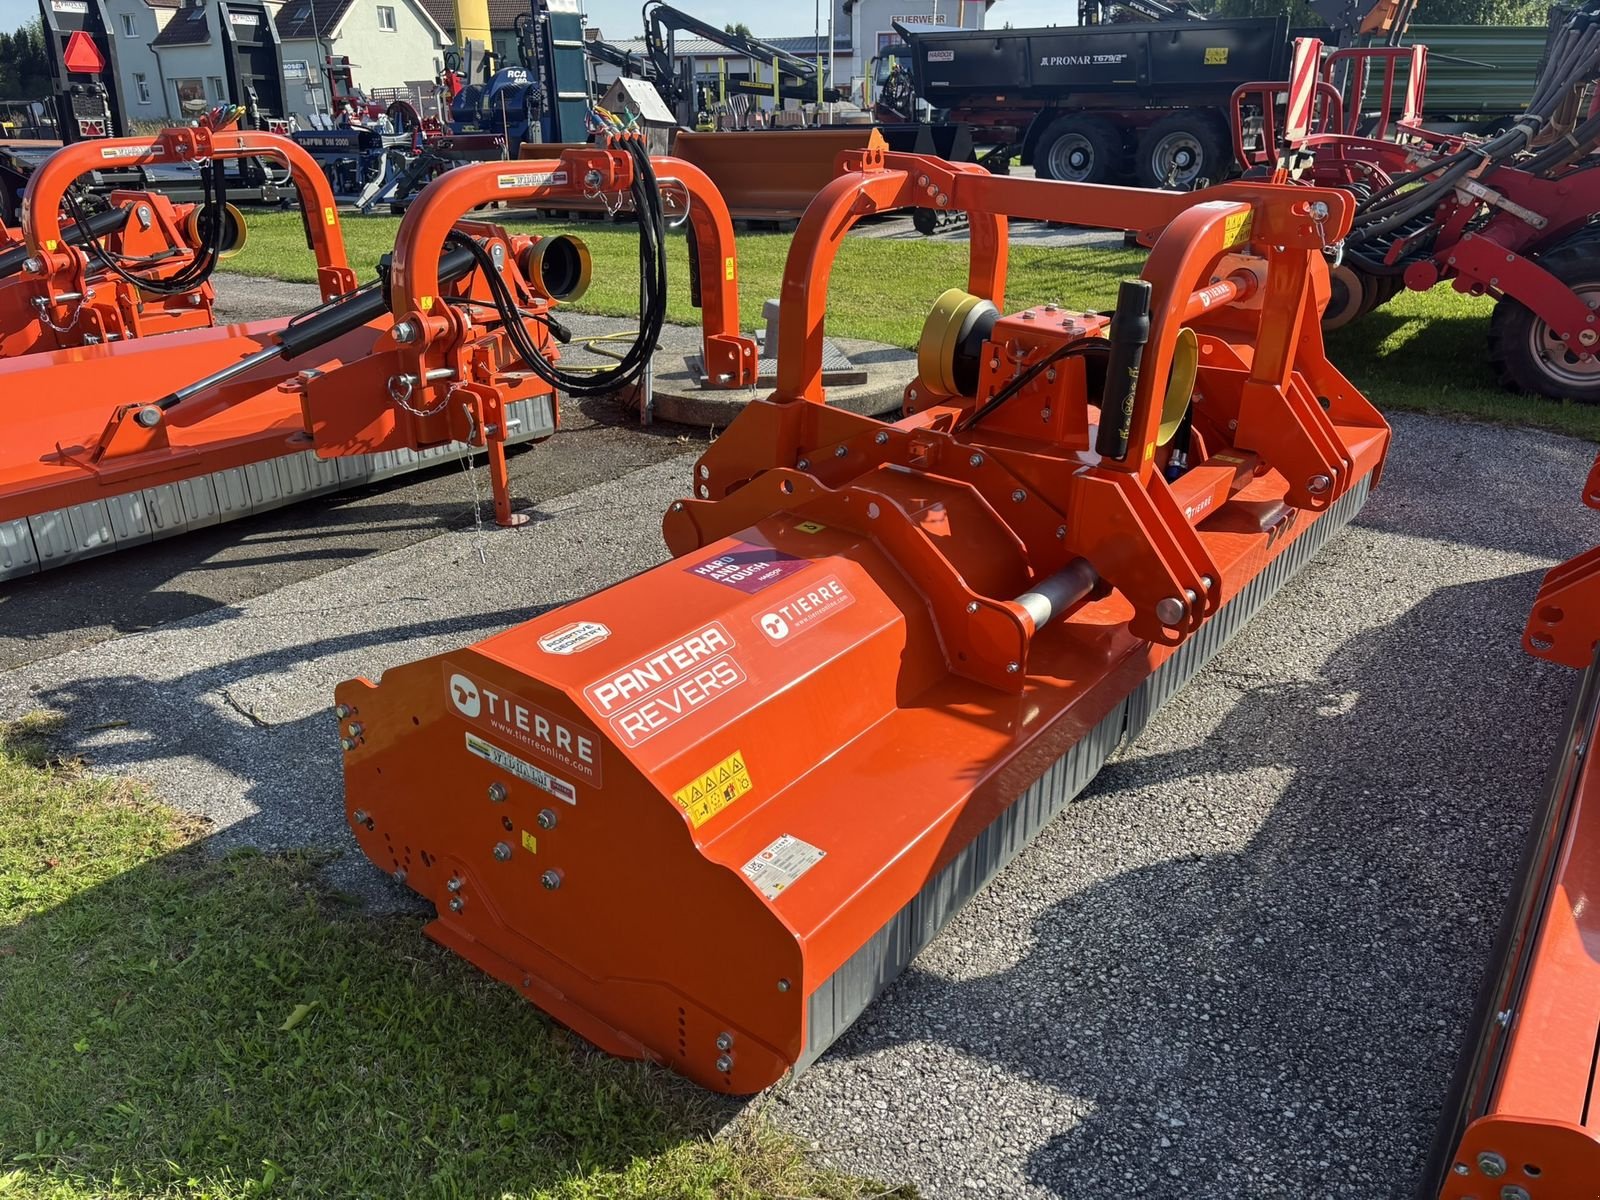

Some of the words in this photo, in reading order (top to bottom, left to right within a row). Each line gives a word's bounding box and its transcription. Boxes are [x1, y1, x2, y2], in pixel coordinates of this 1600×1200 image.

[891, 15, 945, 24] FEUERWEHR
[1050, 55, 1091, 66] PRONAR
[507, 70, 527, 78] RCA
[1205, 284, 1230, 299] TIERRE
[1191, 495, 1212, 517] TIERRE
[694, 556, 735, 575] HARD
[709, 564, 740, 580] AND
[721, 562, 770, 584] TOUGH
[779, 580, 844, 621] TIERRE
[593, 628, 728, 710] PANTERA
[618, 661, 738, 740] REVERS
[482, 689, 593, 764] TIERRE
[490, 718, 593, 776] www.tierreonline.com
